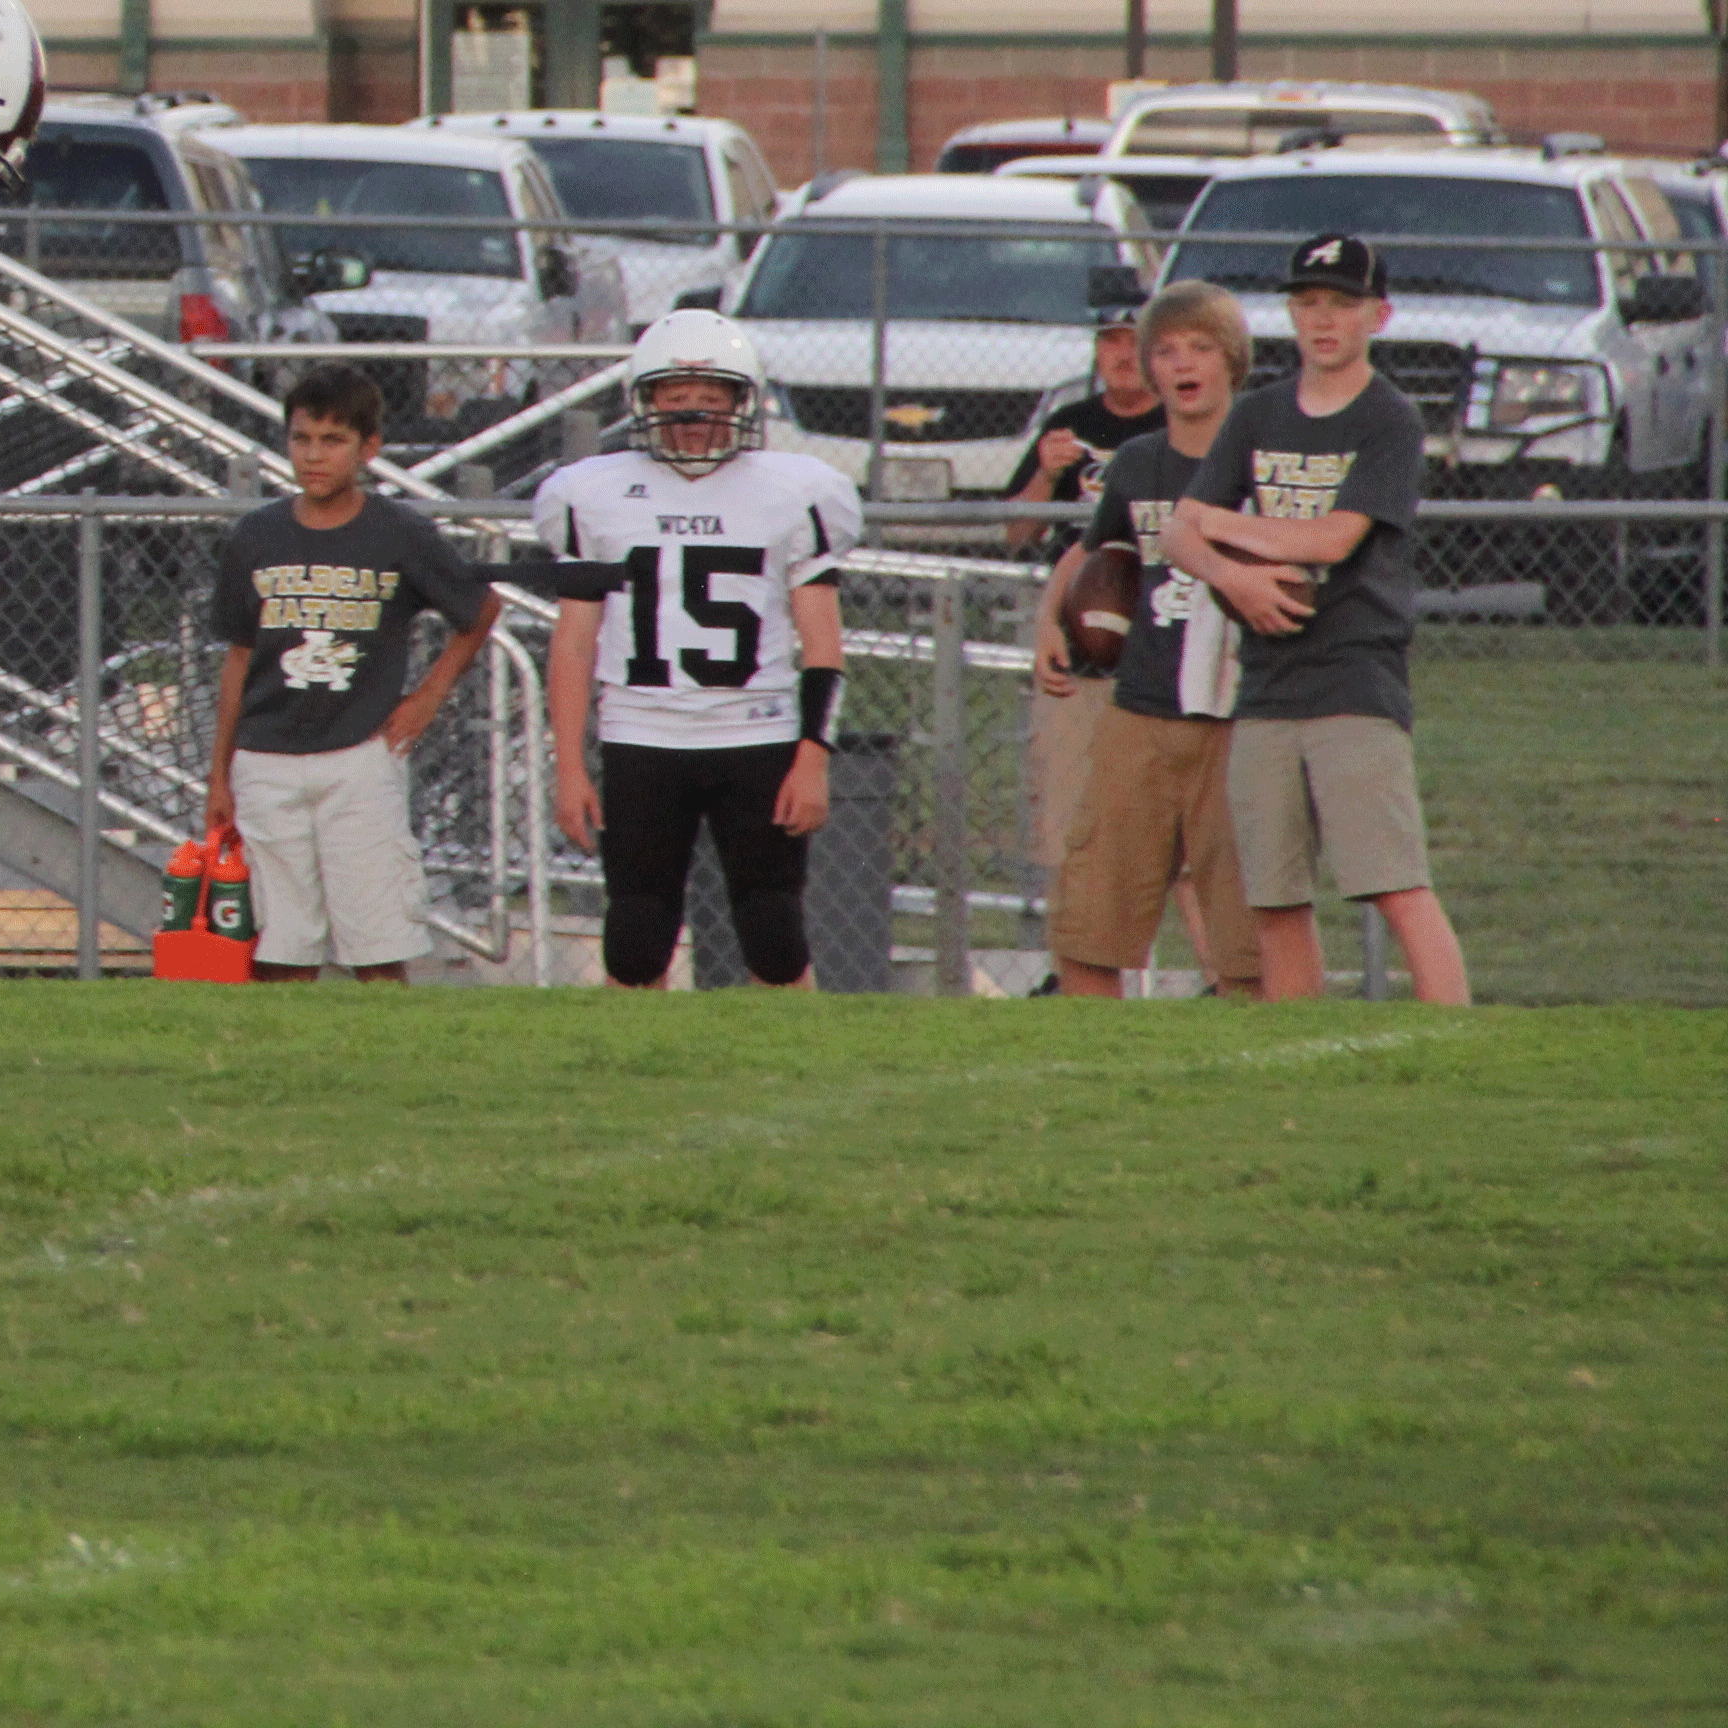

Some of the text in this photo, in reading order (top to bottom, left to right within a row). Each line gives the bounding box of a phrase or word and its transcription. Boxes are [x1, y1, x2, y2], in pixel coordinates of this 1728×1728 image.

[251, 564, 401, 602] WILDCAT
[258, 596, 384, 632] NATION
[624, 544, 768, 690] 15
[211, 898, 242, 930] G
